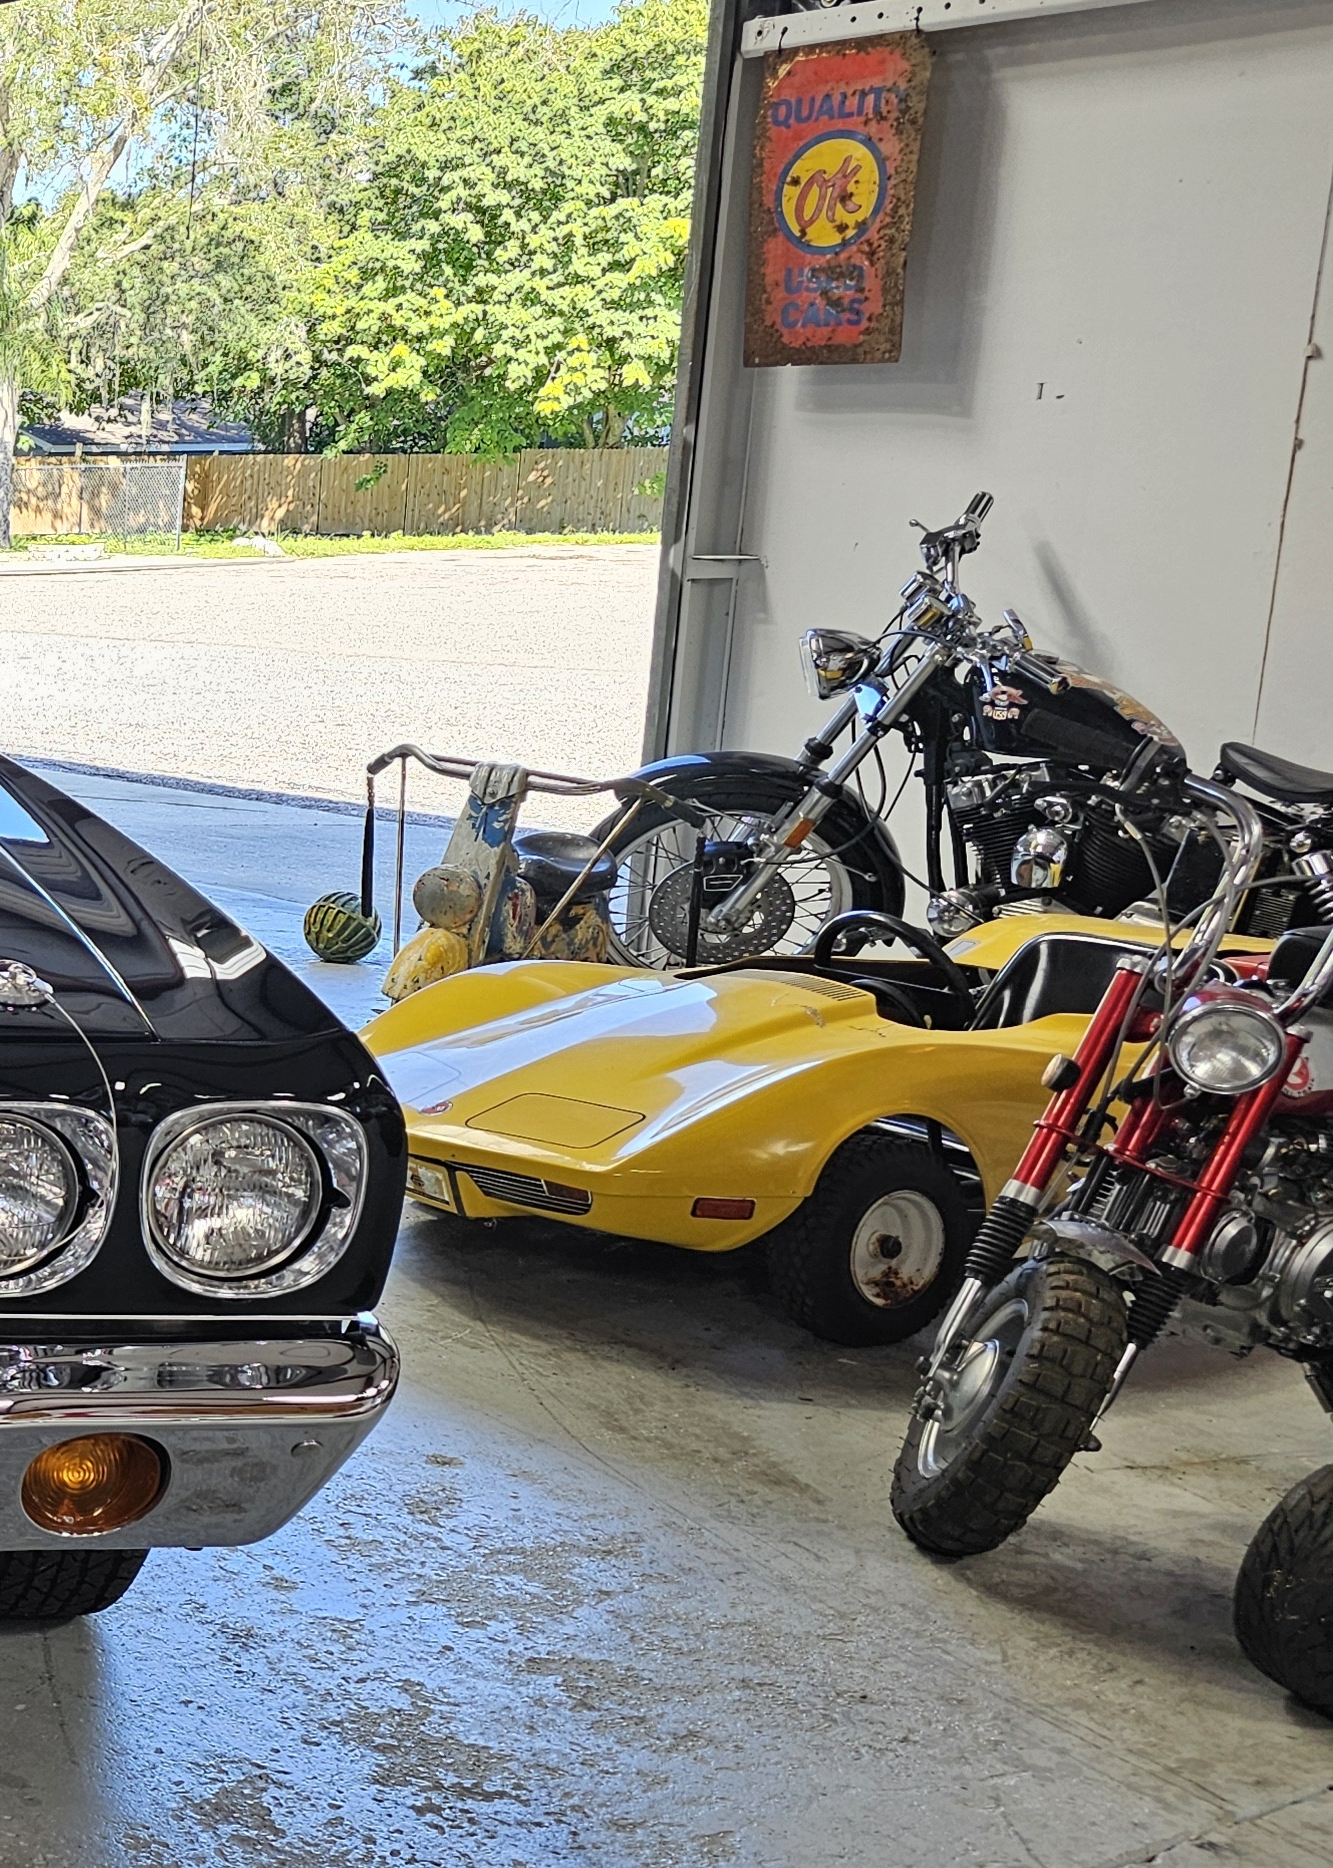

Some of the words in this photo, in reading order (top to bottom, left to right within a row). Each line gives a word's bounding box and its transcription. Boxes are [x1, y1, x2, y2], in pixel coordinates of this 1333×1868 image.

[794, 155, 862, 228] OK
[785, 264, 864, 296] USED
[780, 298, 864, 330] CARS
